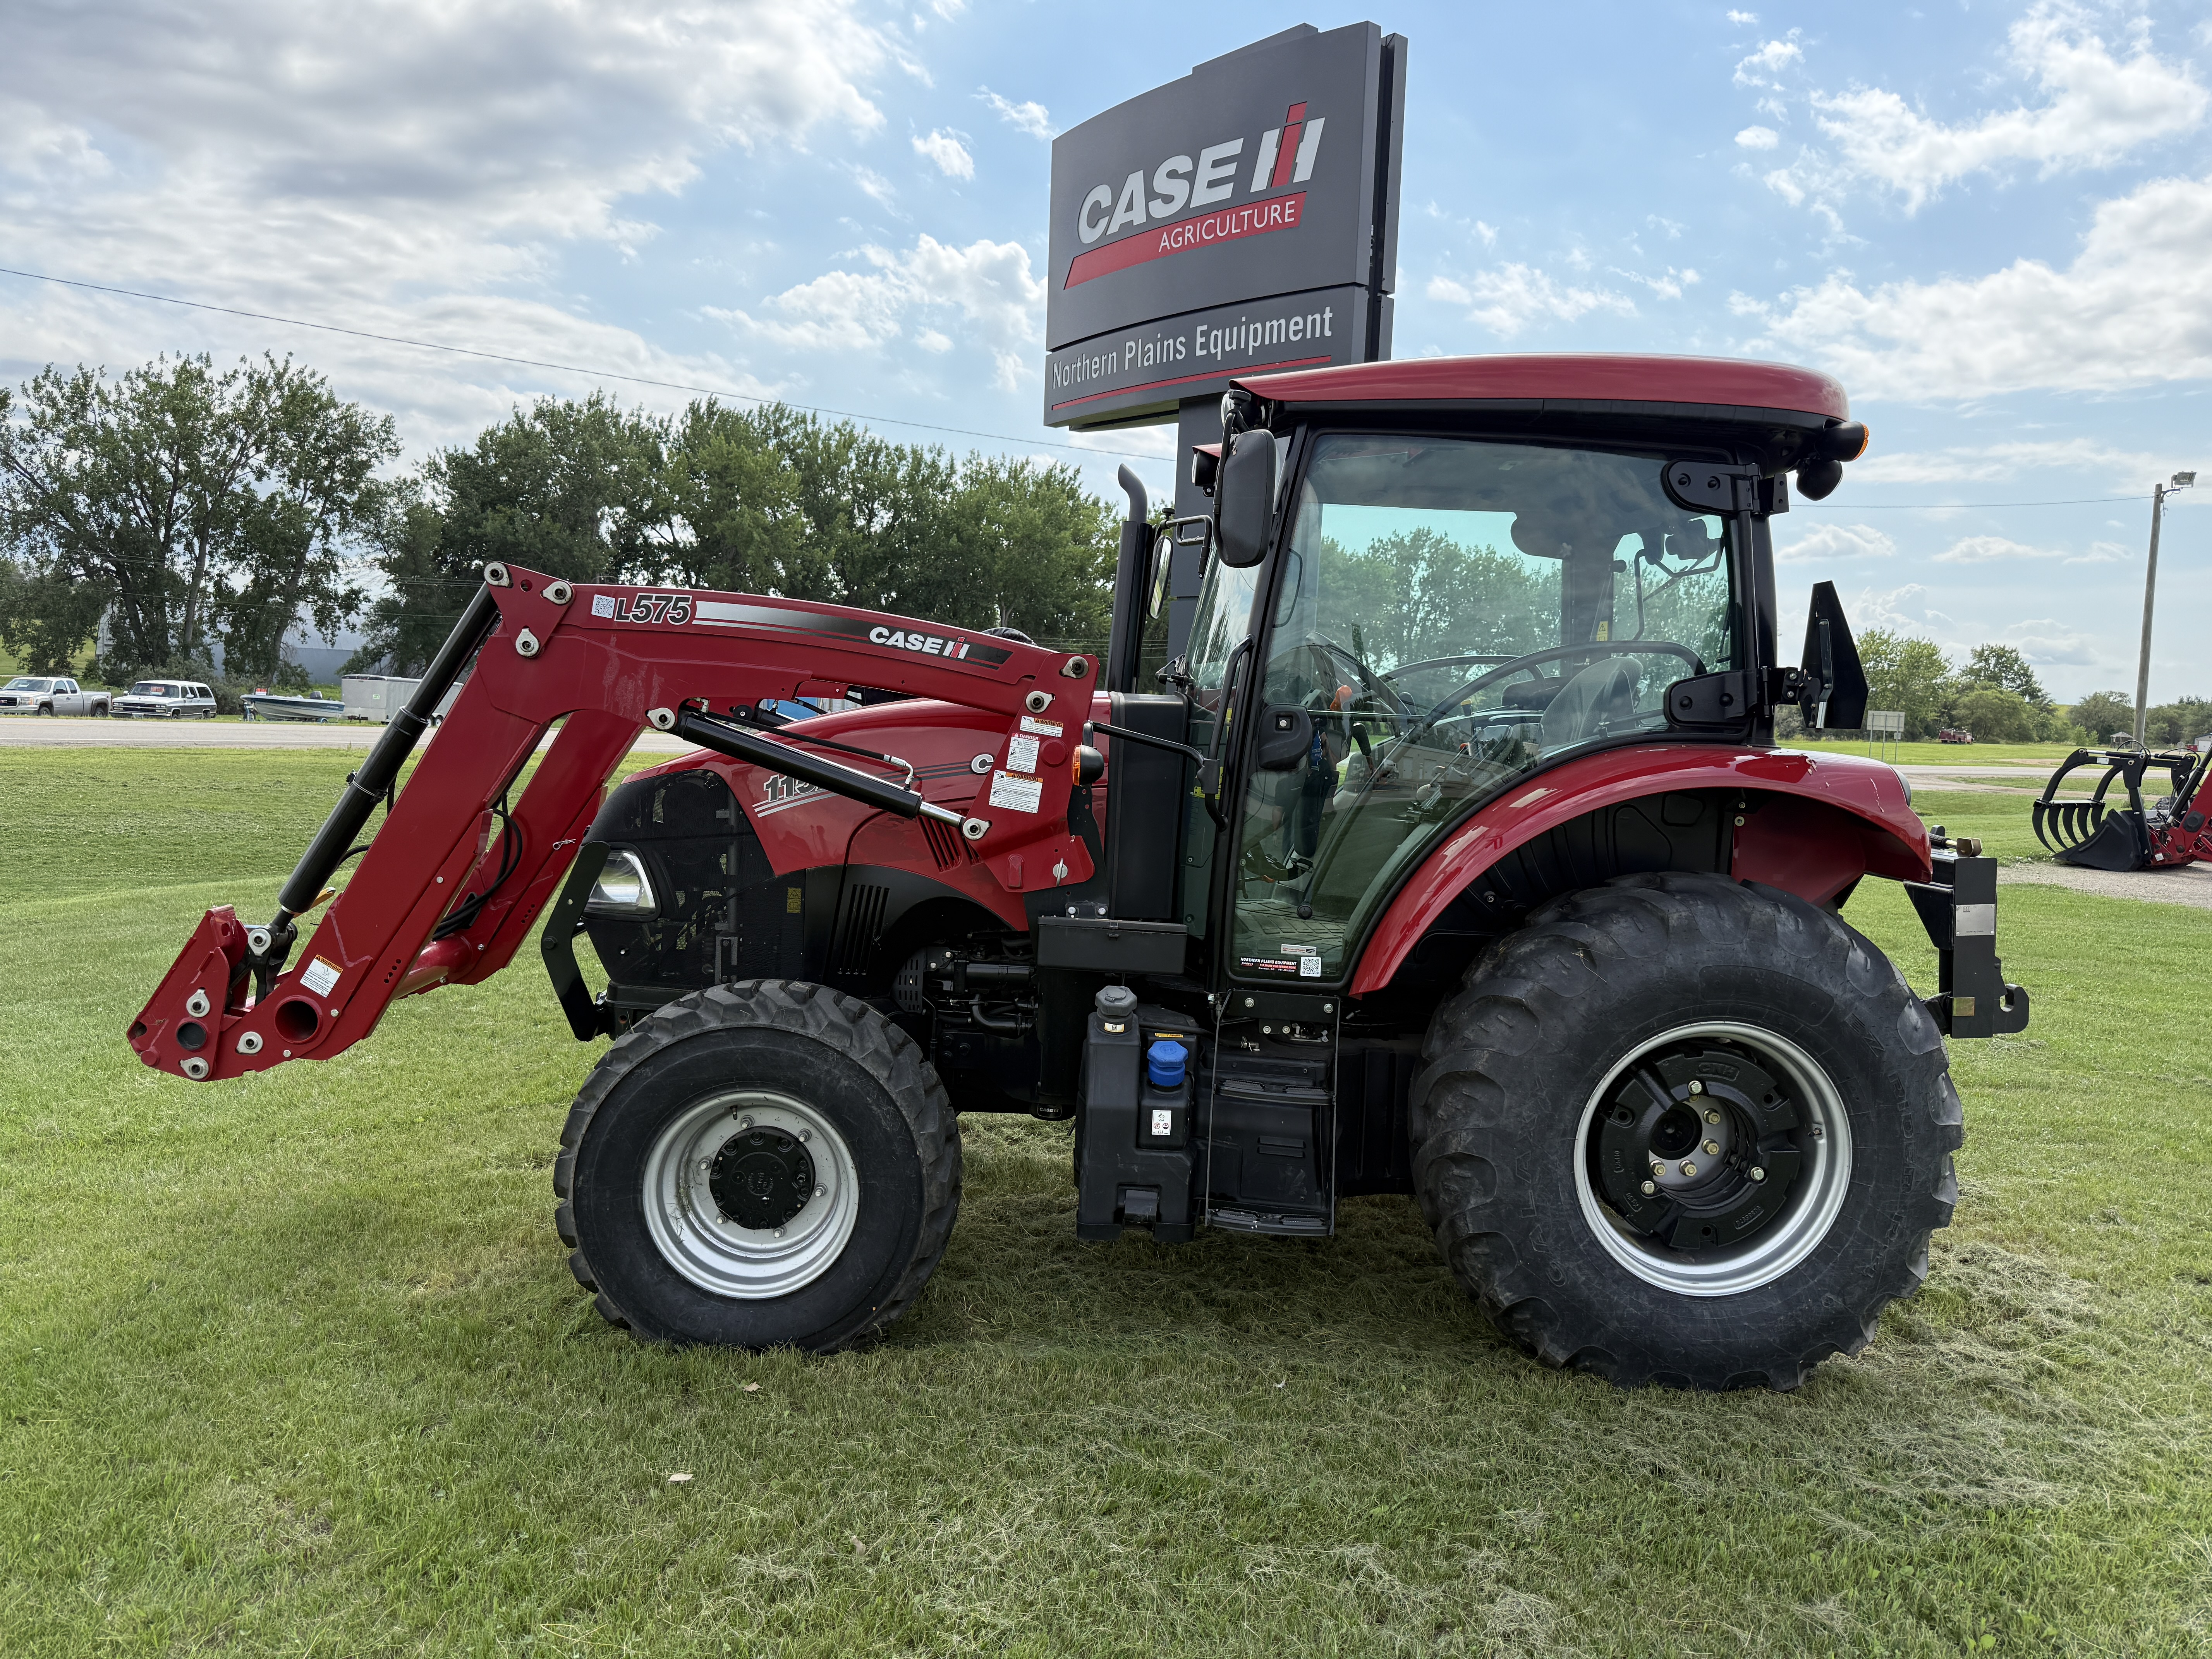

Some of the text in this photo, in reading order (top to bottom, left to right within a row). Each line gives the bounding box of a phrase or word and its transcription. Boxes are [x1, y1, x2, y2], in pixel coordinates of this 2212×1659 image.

[1078, 101, 1325, 244] CASE IH
[1158, 200, 1297, 253] AGRICULTURE
[1053, 306, 1333, 390] Northern Plains Equipment
[614, 592, 693, 625] L575
[869, 626, 970, 659] CASE IH
[1040, 719, 1062, 727] WARNING
[321, 957, 342, 973] WARNING
